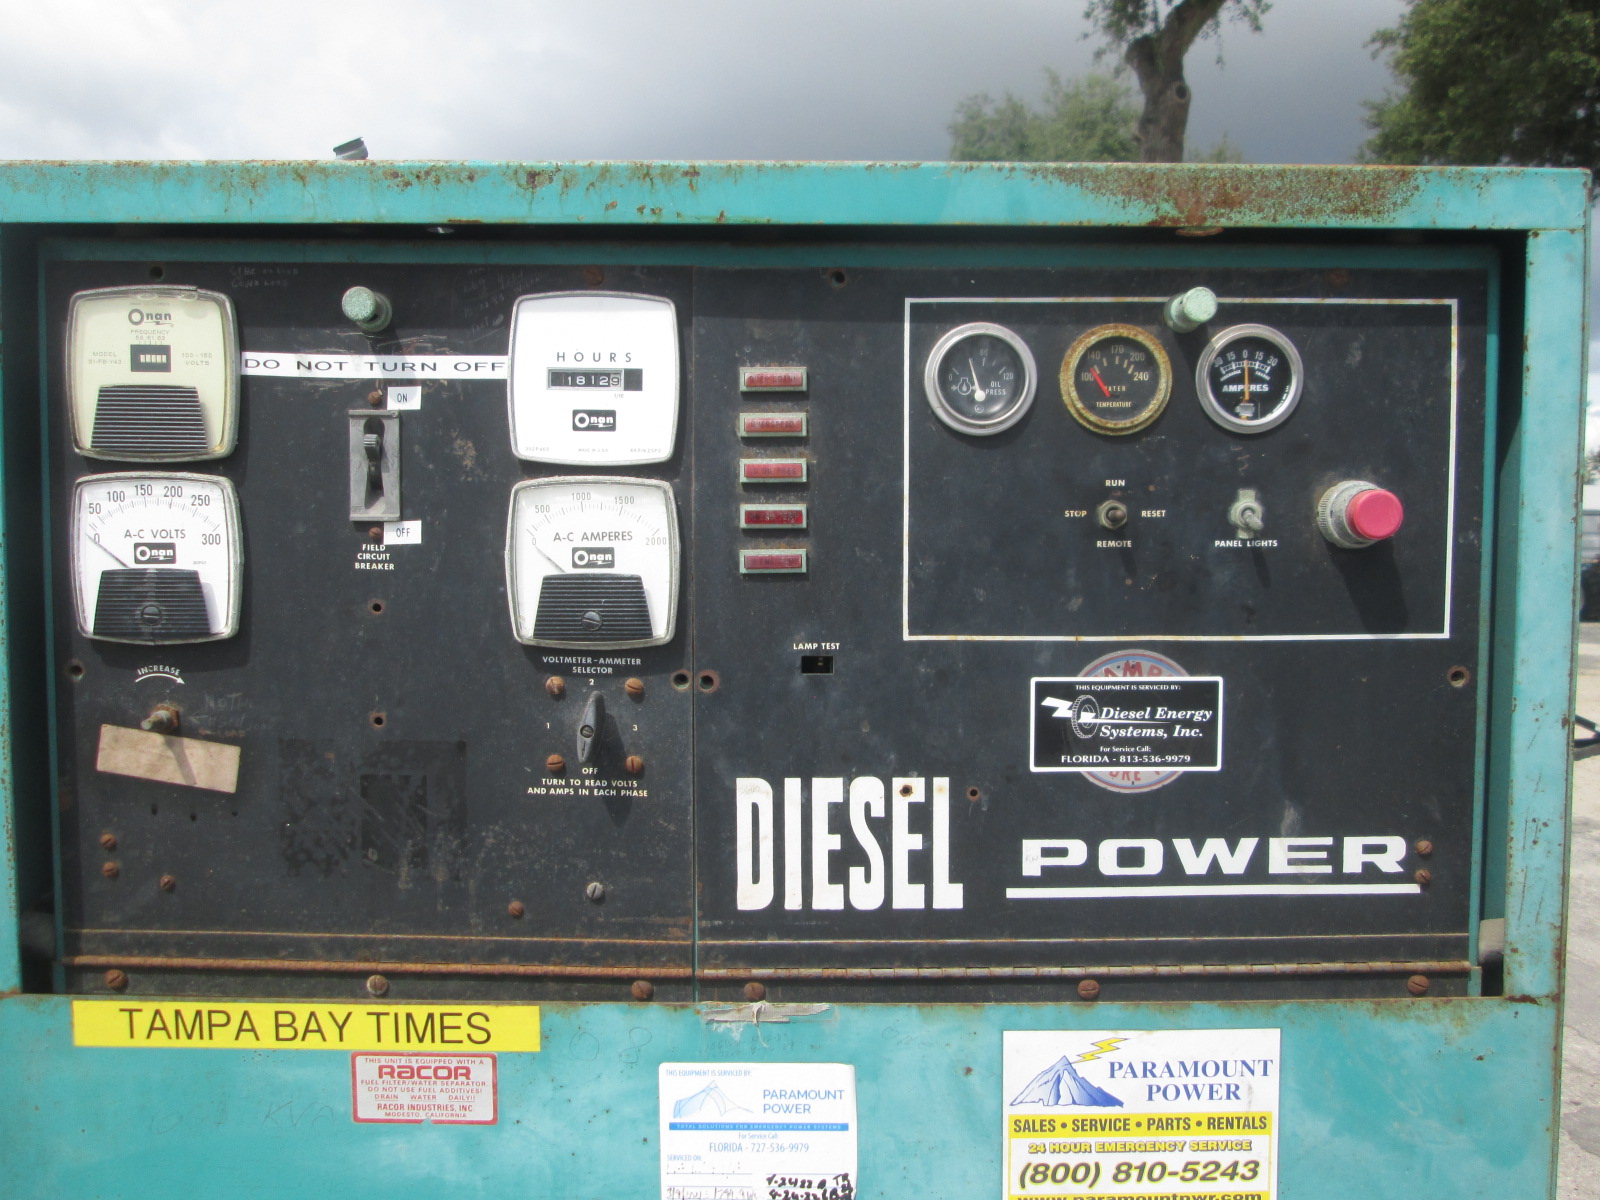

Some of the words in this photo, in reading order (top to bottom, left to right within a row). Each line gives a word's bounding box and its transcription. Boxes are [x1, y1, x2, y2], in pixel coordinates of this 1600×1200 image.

[128, 308, 172, 326] Onan
[1087, 351, 1101, 360] 140
[1111, 345, 1124, 354] 170
[557, 352, 632, 362] HOURS
[1130, 352, 1145, 361] 200
[1226, 351, 1236, 360] 15
[1242, 349, 1248, 358] 0
[1255, 351, 1264, 361] 15
[1267, 355, 1278, 366] 30
[244, 358, 281, 369] DO
[296, 360, 348, 371] NOT
[365, 361, 437, 372] TURN
[454, 362, 506, 372] OFF
[1133, 372, 1149, 381] 240
[396, 393, 408, 403] ON
[574, 412, 614, 428] Onan
[134, 484, 153, 496] 150
[163, 486, 183, 498] 200
[106, 491, 126, 503] 100
[191, 494, 210, 507] 250
[571, 492, 591, 501] 1000
[614, 496, 635, 504] 1500
[88, 503, 101, 515] 50
[535, 505, 550, 514] 500
[93, 533, 100, 544] 0
[124, 529, 145, 539] A-C
[151, 529, 186, 539] VOLTS
[396, 528, 411, 537] OFF
[553, 532, 574, 542] A-C
[581, 531, 633, 541] AMPERES
[201, 533, 221, 545] 300
[645, 537, 667, 546] 2000
[136, 545, 174, 561] Onan
[357, 552, 391, 561] CIRCUIT
[574, 550, 612, 565] Onan
[354, 562, 395, 570] BREAKER
[136, 664, 180, 676] INCREASE
[572, 666, 613, 674] SELECTOR
[1100, 707, 1151, 719] Diesel
[1154, 707, 1212, 722] Energy
[1099, 725, 1168, 740] Systems,
[1172, 725, 1203, 737] Inc.
[1061, 755, 1109, 763] FLORIDA
[736, 776, 964, 911] DIESEL
[1022, 836, 1405, 876] POWER
[119, 1008, 260, 1042] TAMPA
[274, 1010, 353, 1042] BAY
[366, 1012, 492, 1045] TIMES
[1109, 1059, 1274, 1079] PARAMOUNT
[762, 1090, 845, 1100] PARAMOUNT
[1146, 1083, 1242, 1102] POWER
[763, 1104, 811, 1114] POWER
[1013, 1118, 1056, 1133] SALES
[1071, 1117, 1131, 1132] SERVICE
[1147, 1116, 1191, 1131] PARTS
[1207, 1116, 1267, 1131] RENTALS
[709, 1143, 743, 1152] FLORIDA
[751, 1143, 810, 1153] 727-536-9979
[1028, 1143, 1045, 1154] 24
[1049, 1142, 1092, 1153] HOUR
[1095, 1140, 1185, 1153] EMERGENCY
[1189, 1139, 1252, 1152] SERVICE
[1019, 1161, 1101, 1189] (800)
[1112, 1160, 1260, 1183] 810-5243
